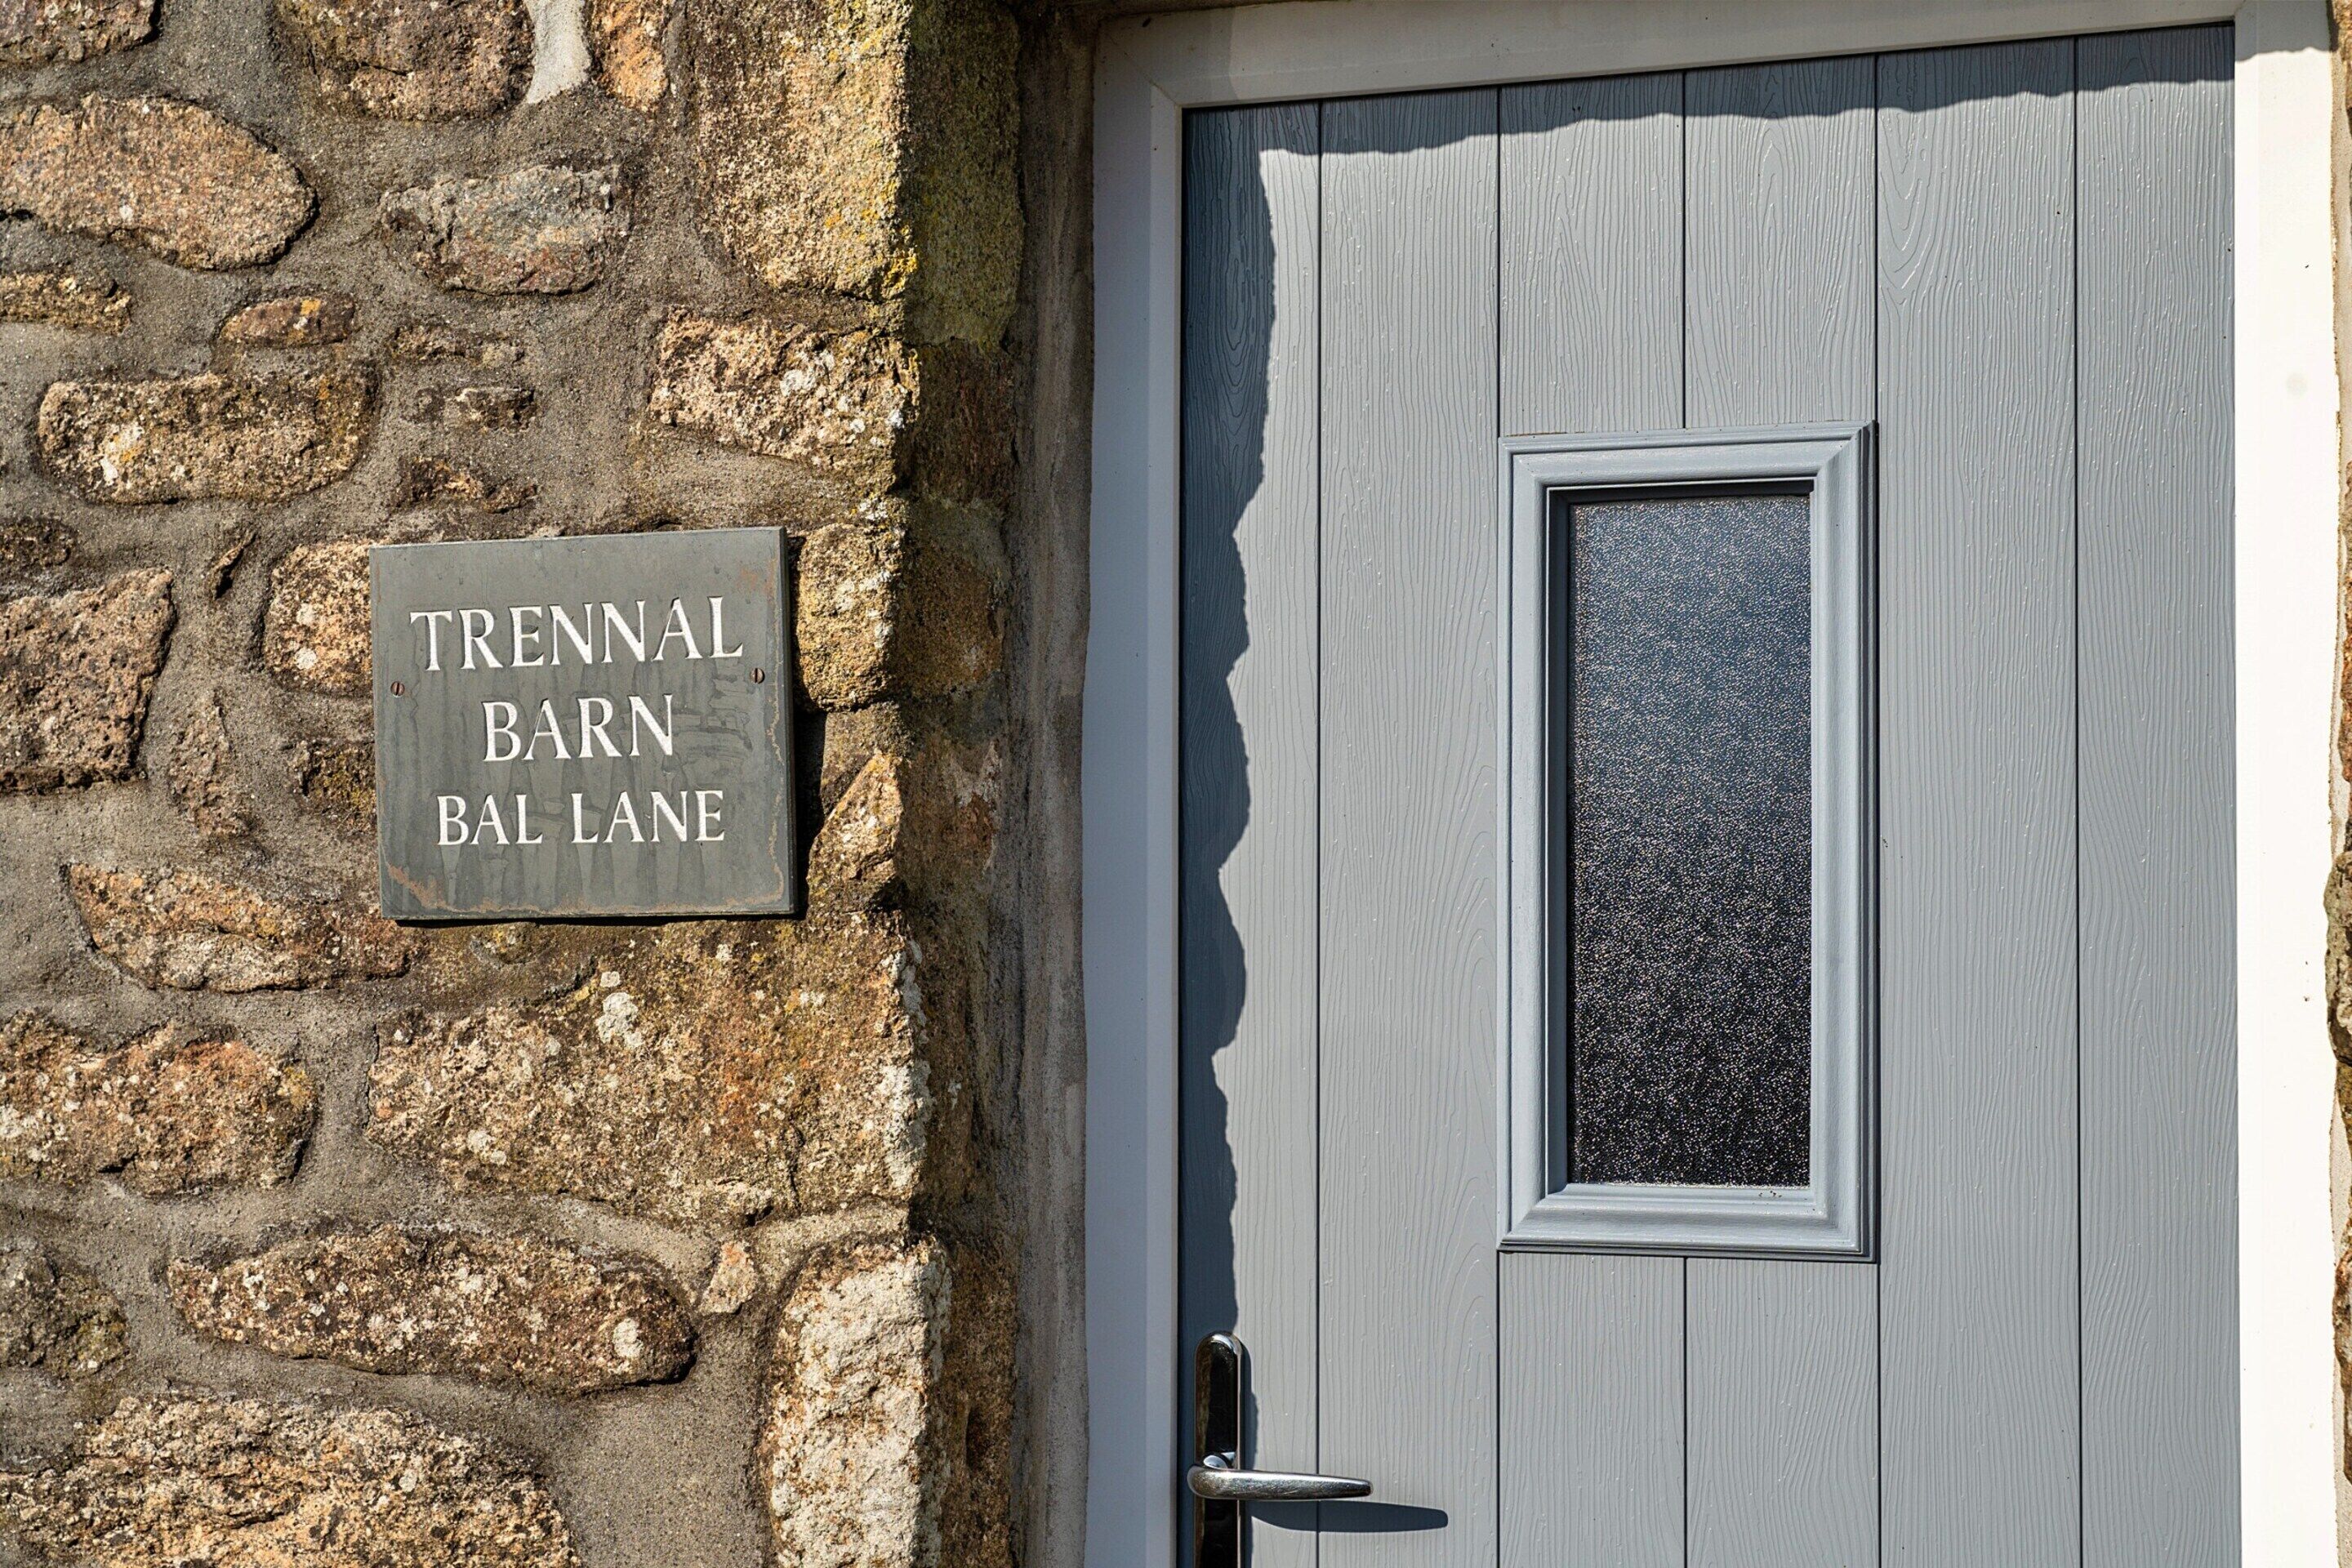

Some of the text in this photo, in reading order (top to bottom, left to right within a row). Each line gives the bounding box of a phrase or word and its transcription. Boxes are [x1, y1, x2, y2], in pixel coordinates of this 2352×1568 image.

[409, 596, 744, 671] TRENNAL
[482, 694, 673, 762] BARN
[436, 790, 725, 846] BAL LANE
